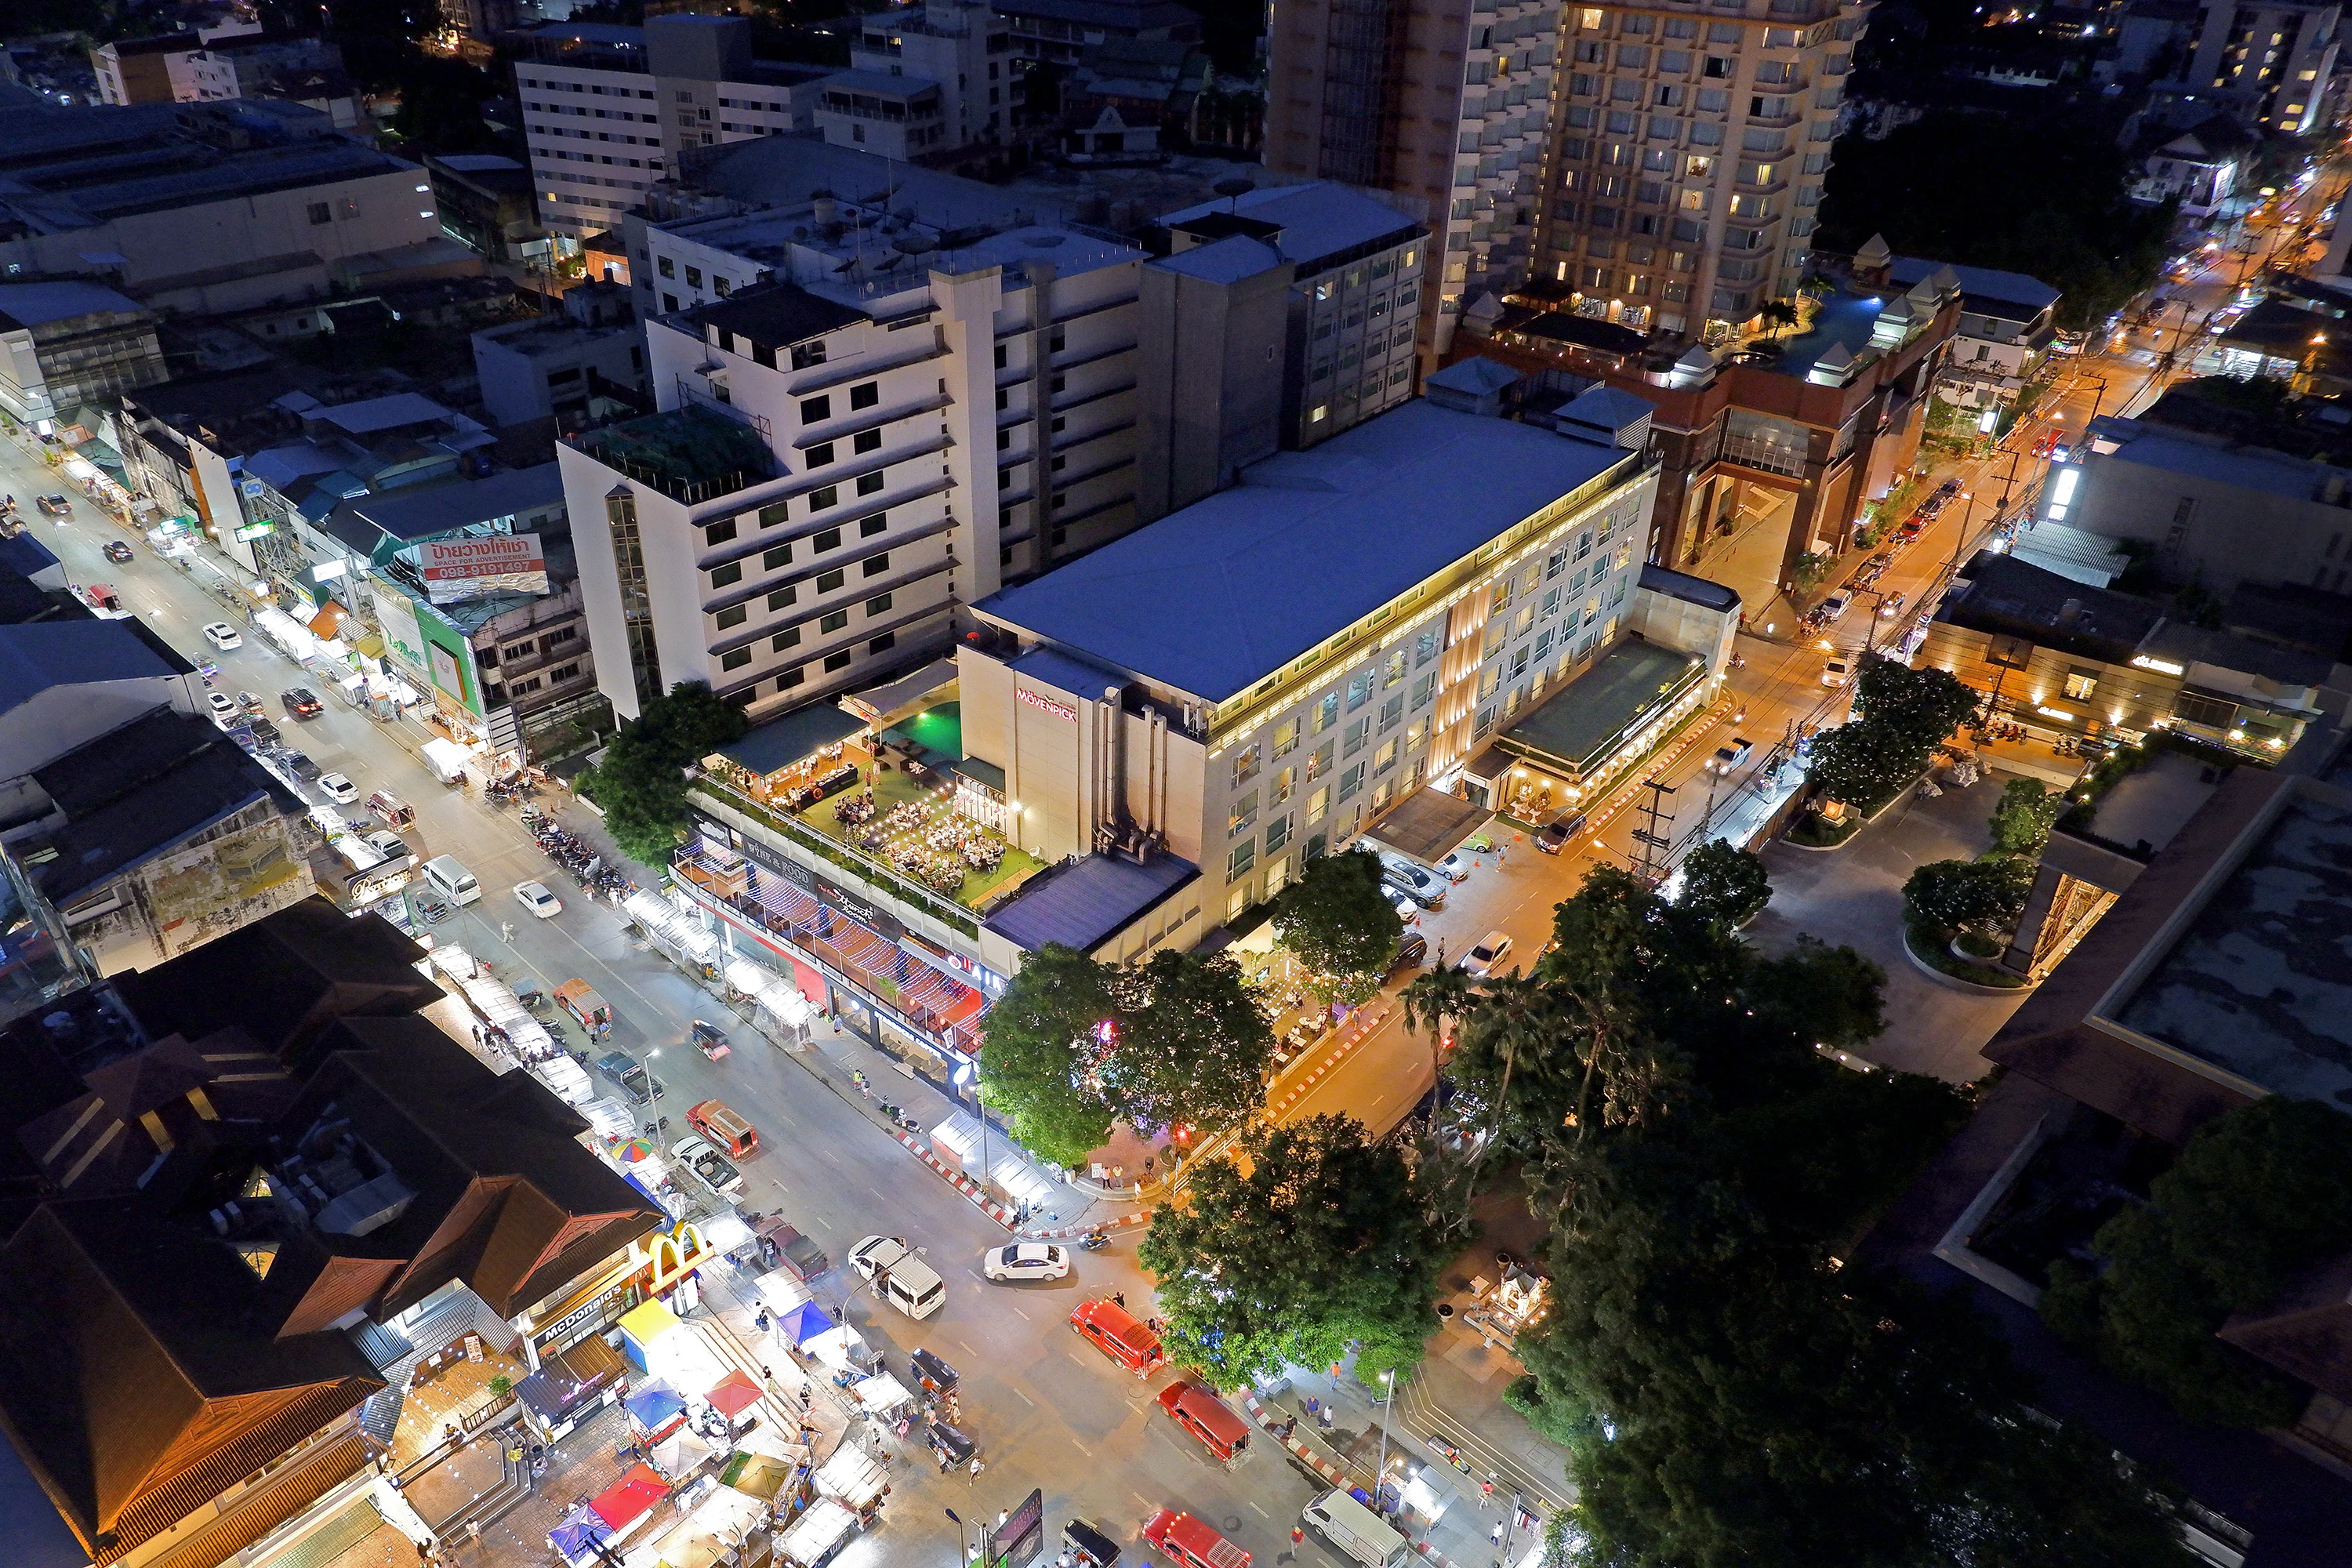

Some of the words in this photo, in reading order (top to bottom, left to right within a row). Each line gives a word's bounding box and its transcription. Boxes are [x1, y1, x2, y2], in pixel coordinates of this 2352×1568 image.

[431, 537, 530, 559] ป้ายว่างให้เช่า
[476, 553, 531, 563] ADVERTISEMENT
[439, 561, 530, 578] 098-9191497
[1016, 688, 1076, 722] MÖVENPICK
[747, 841, 771, 863] WINE
[772, 857, 781, 868] &
[782, 861, 809, 884] FOOD
[836, 894, 873, 920] Munch
[841, 906, 868, 924] Room
[545, 1285, 622, 1341] McDonald's
